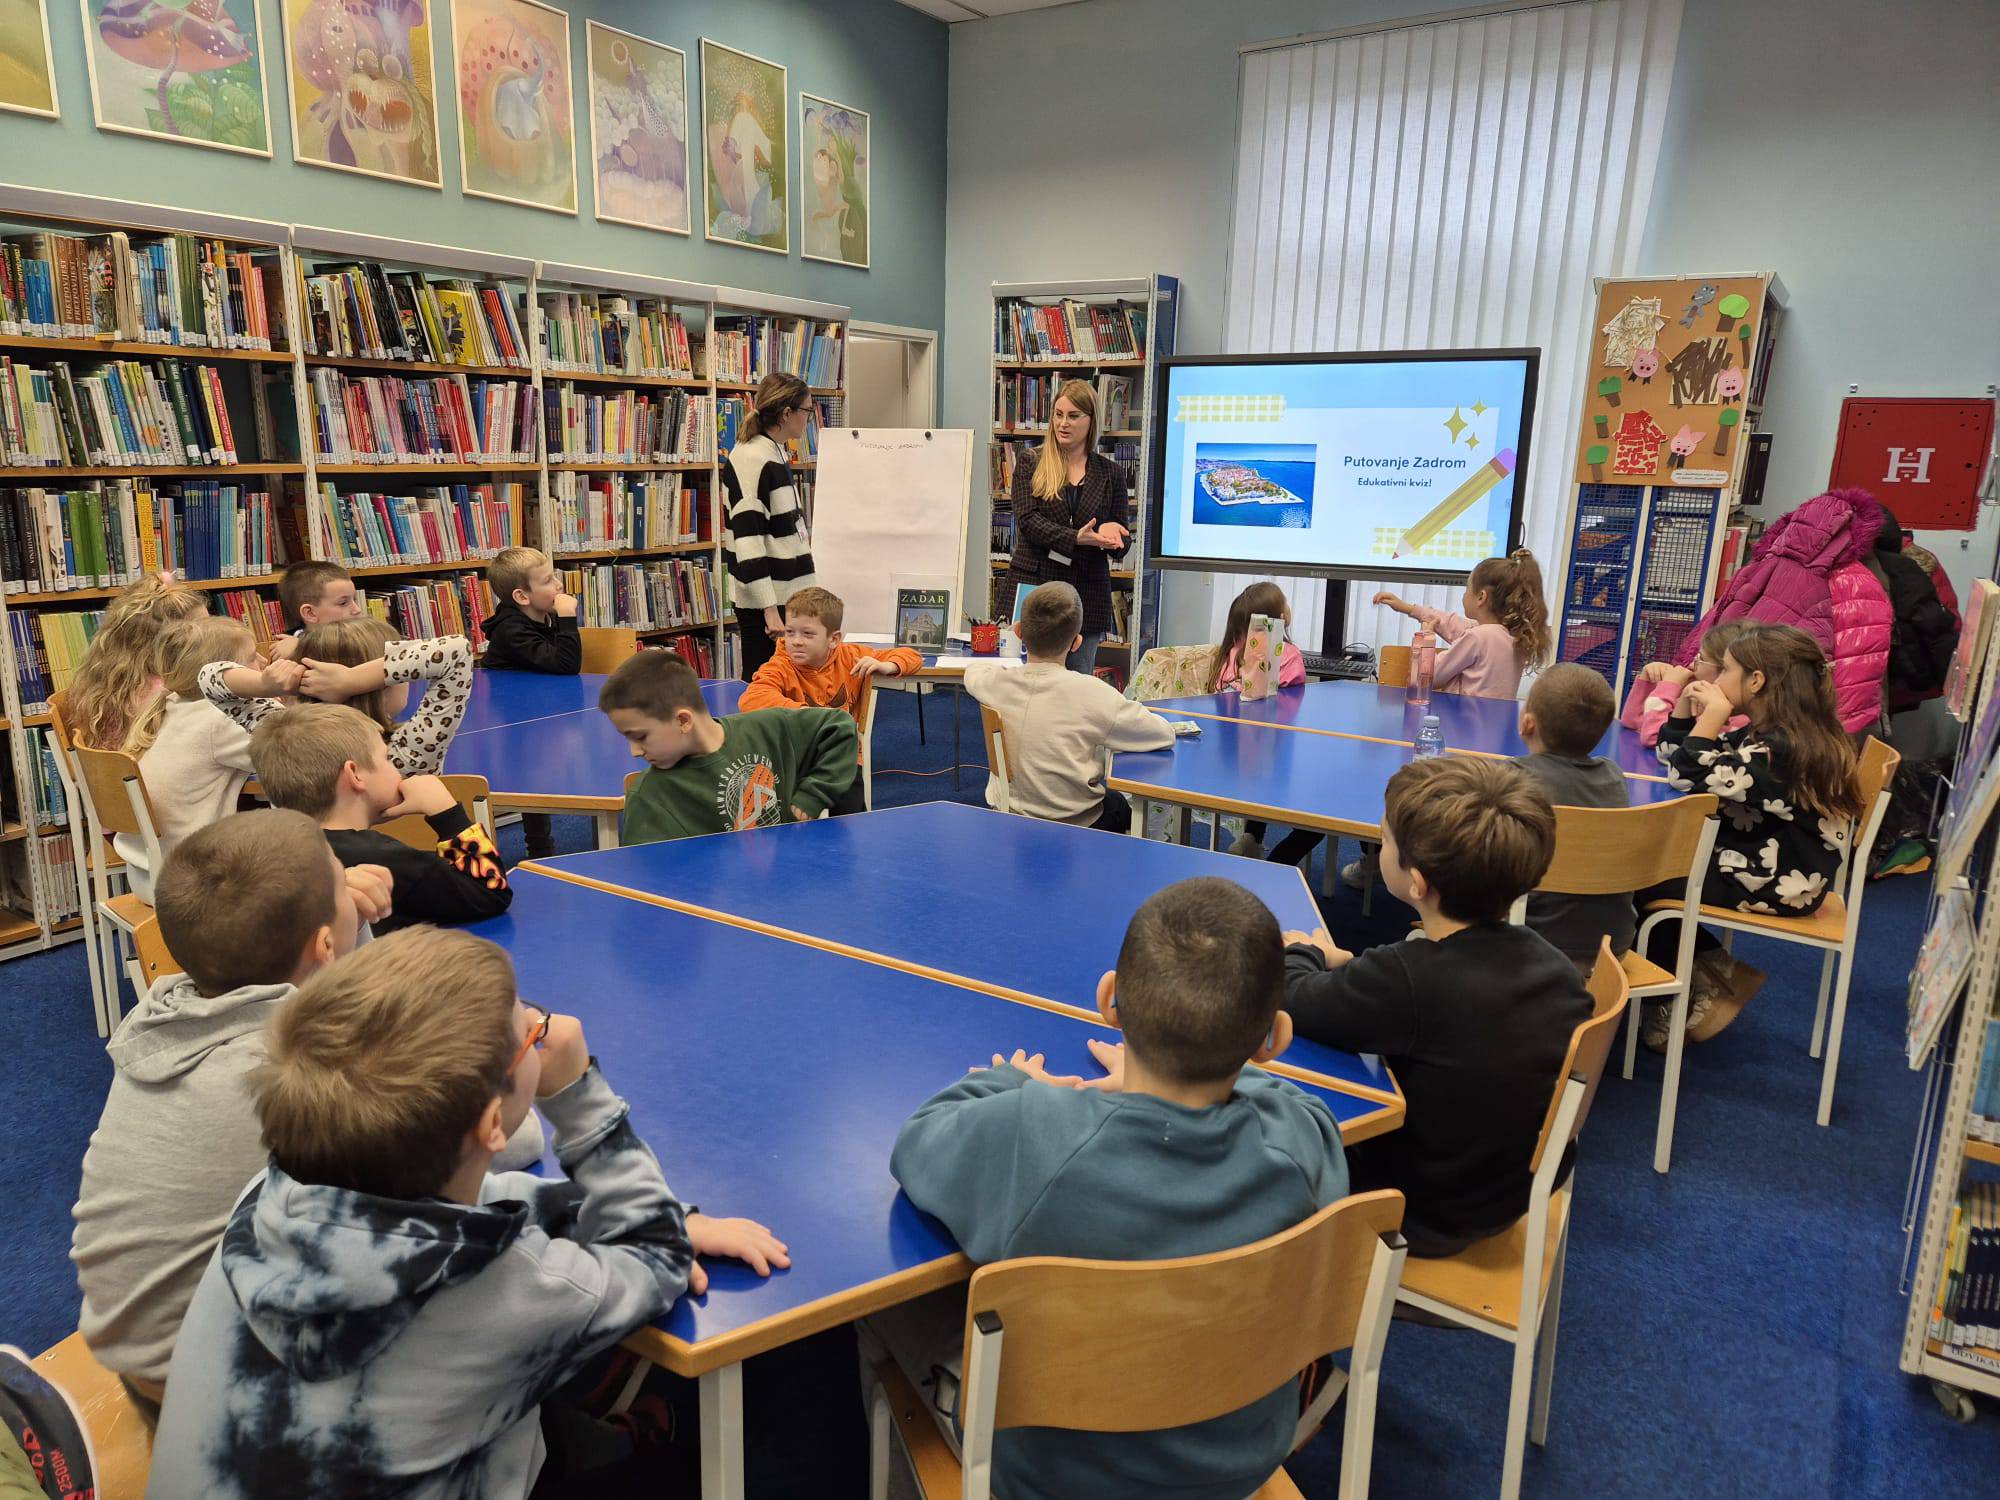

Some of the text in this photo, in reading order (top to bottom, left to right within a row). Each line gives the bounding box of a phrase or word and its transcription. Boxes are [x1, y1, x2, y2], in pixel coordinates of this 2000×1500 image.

[60, 260, 74, 321] PRETPOVIJEST
[1344, 455, 1466, 470] Putovanje Zadrom
[1358, 477, 1432, 487] Edukativni kviz!
[901, 594, 945, 604] ZADAR
[716, 774, 729, 815] ALWAYS
[725, 754, 766, 775] BELIEVE
